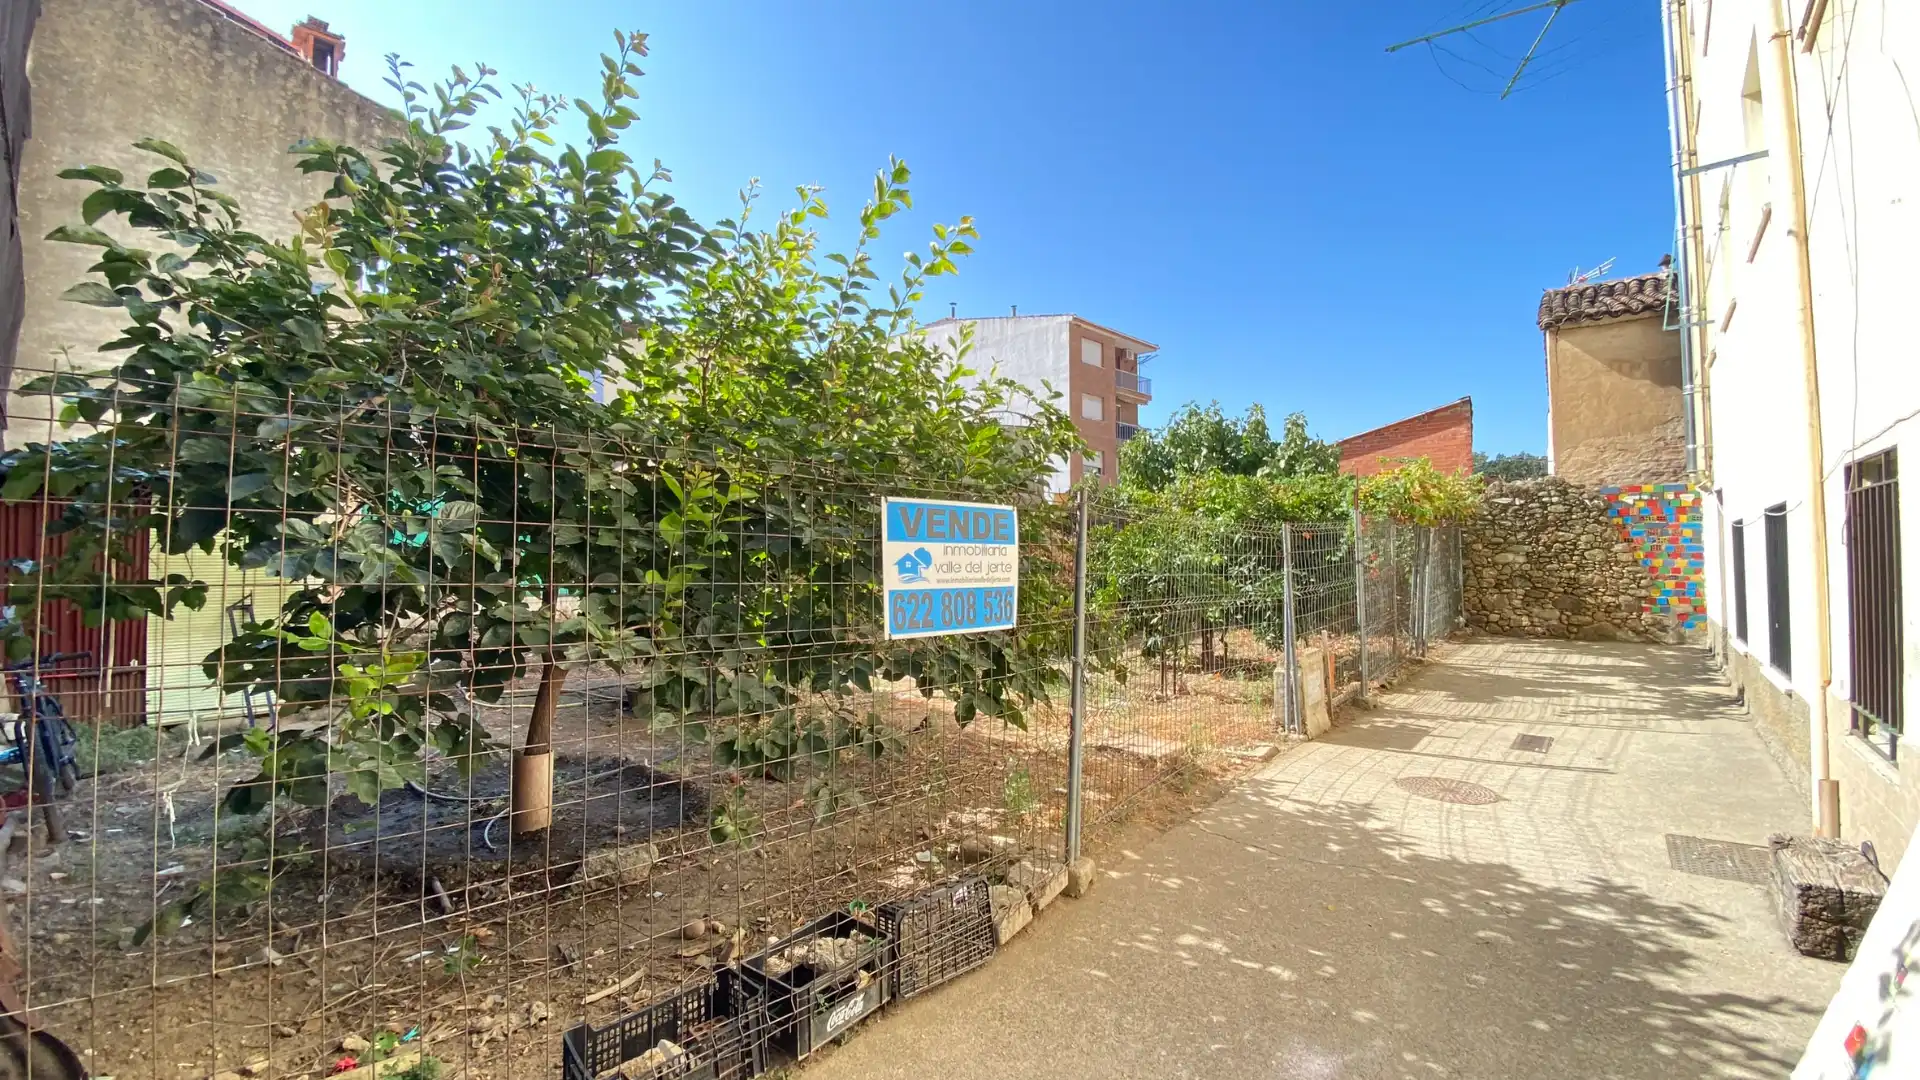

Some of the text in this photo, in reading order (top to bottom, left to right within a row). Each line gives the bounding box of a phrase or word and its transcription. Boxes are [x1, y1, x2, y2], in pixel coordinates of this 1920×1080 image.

[899, 507, 1008, 541] VENDE
[934, 561, 1012, 575] valle del jerte
[893, 590, 1013, 631] 622 808 536
